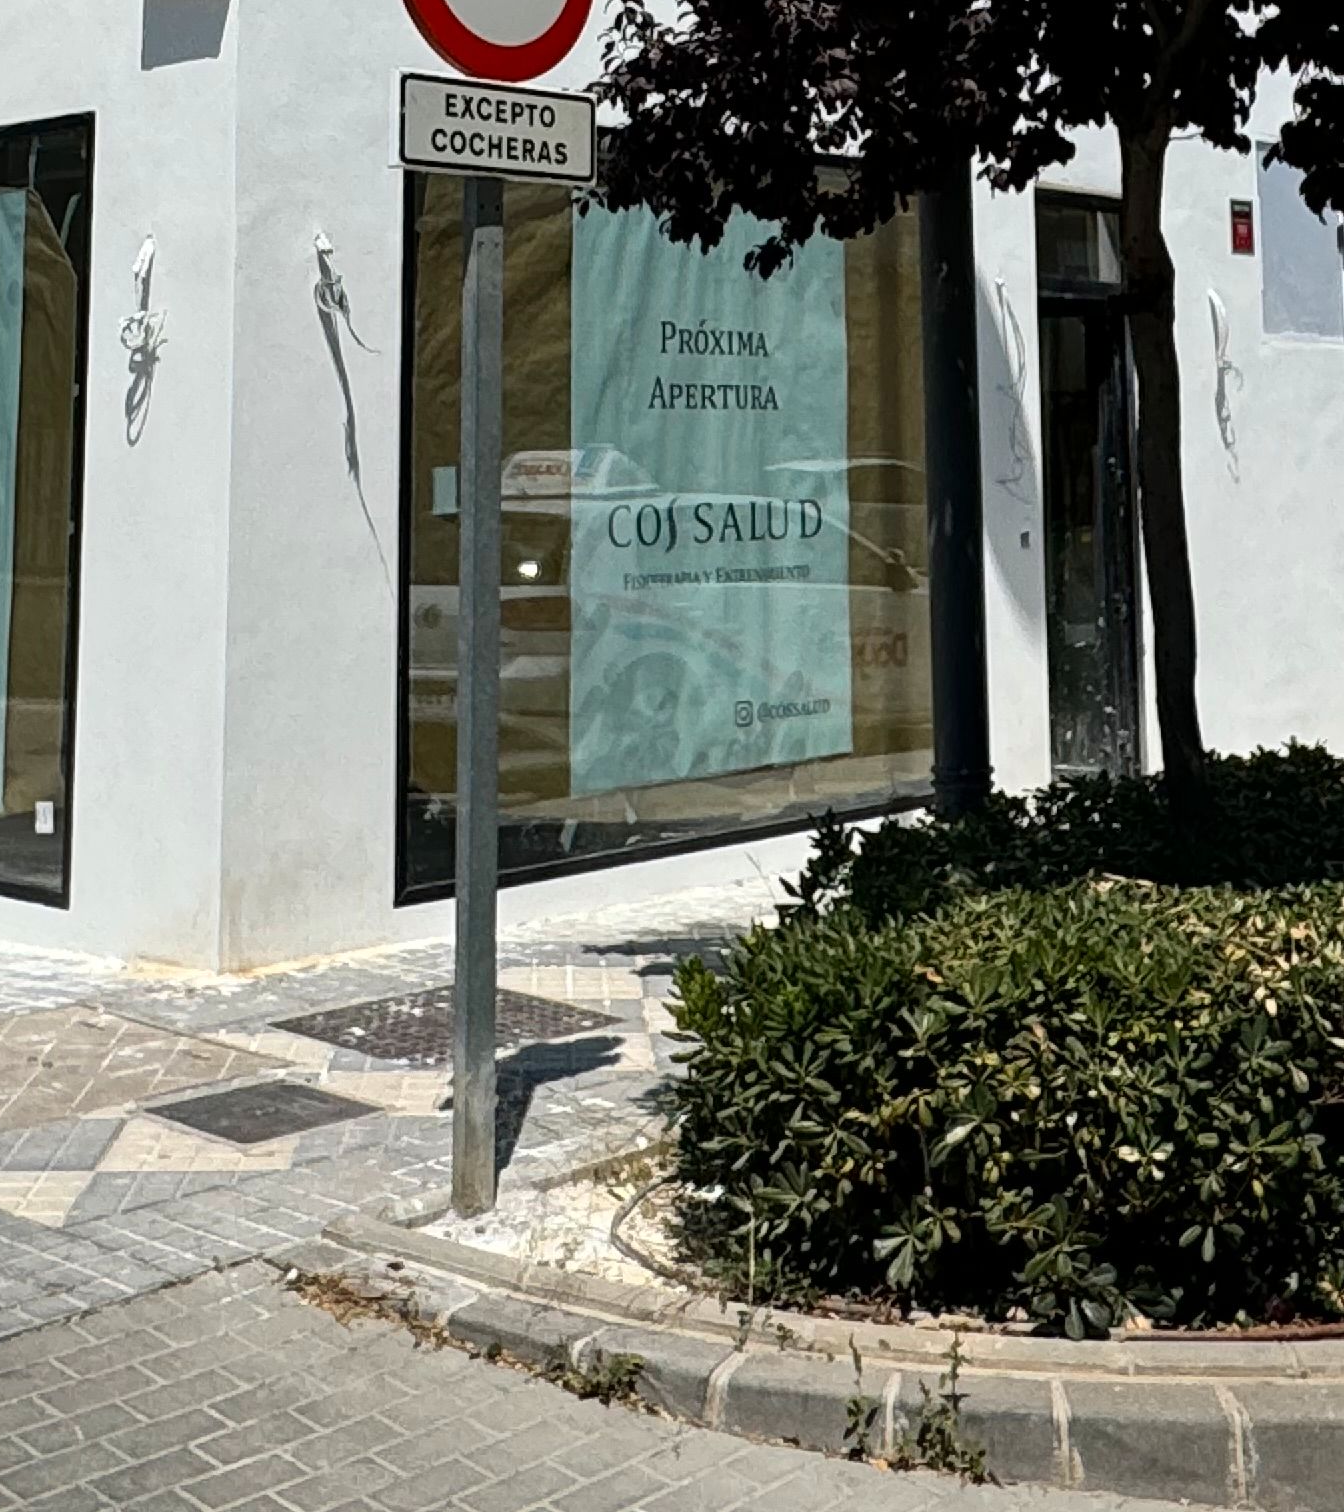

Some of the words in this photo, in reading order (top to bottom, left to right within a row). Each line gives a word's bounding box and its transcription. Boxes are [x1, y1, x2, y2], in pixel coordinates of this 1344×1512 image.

[444, 93, 556, 129] EXCEPTO
[430, 128, 568, 166] COCHERAS
[659, 318, 770, 357] PRÓXIMA
[647, 375, 779, 410] APERTURA
[693, 499, 822, 544] SALUD
